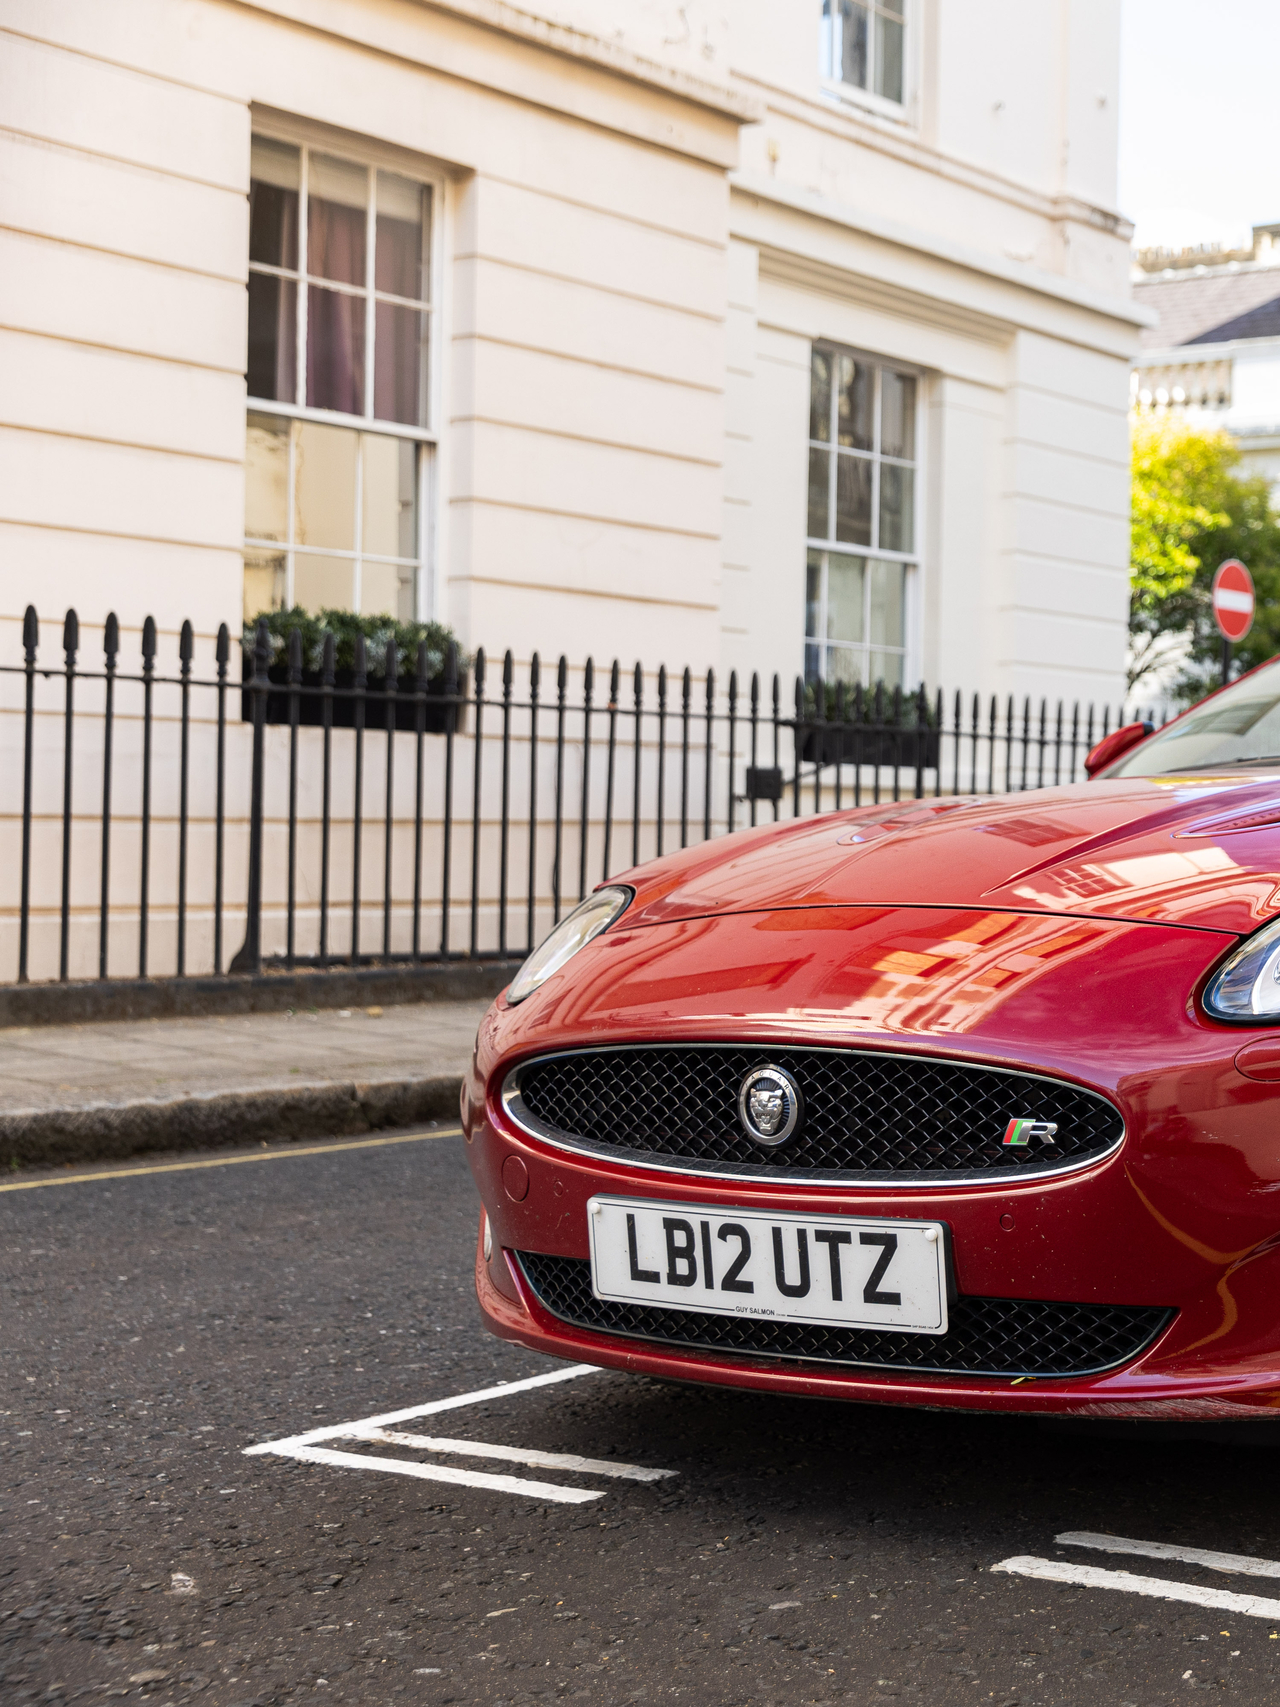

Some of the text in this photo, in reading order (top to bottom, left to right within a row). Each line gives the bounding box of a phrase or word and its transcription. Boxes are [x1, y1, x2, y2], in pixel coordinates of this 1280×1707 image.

[744, 1070, 790, 1090] JAGUAR
[1016, 1121, 1059, 1145] R
[626, 1213, 902, 1306] LB12 UTZ
[735, 1305, 748, 1313] GUY
[749, 1307, 775, 1316] SALMON
